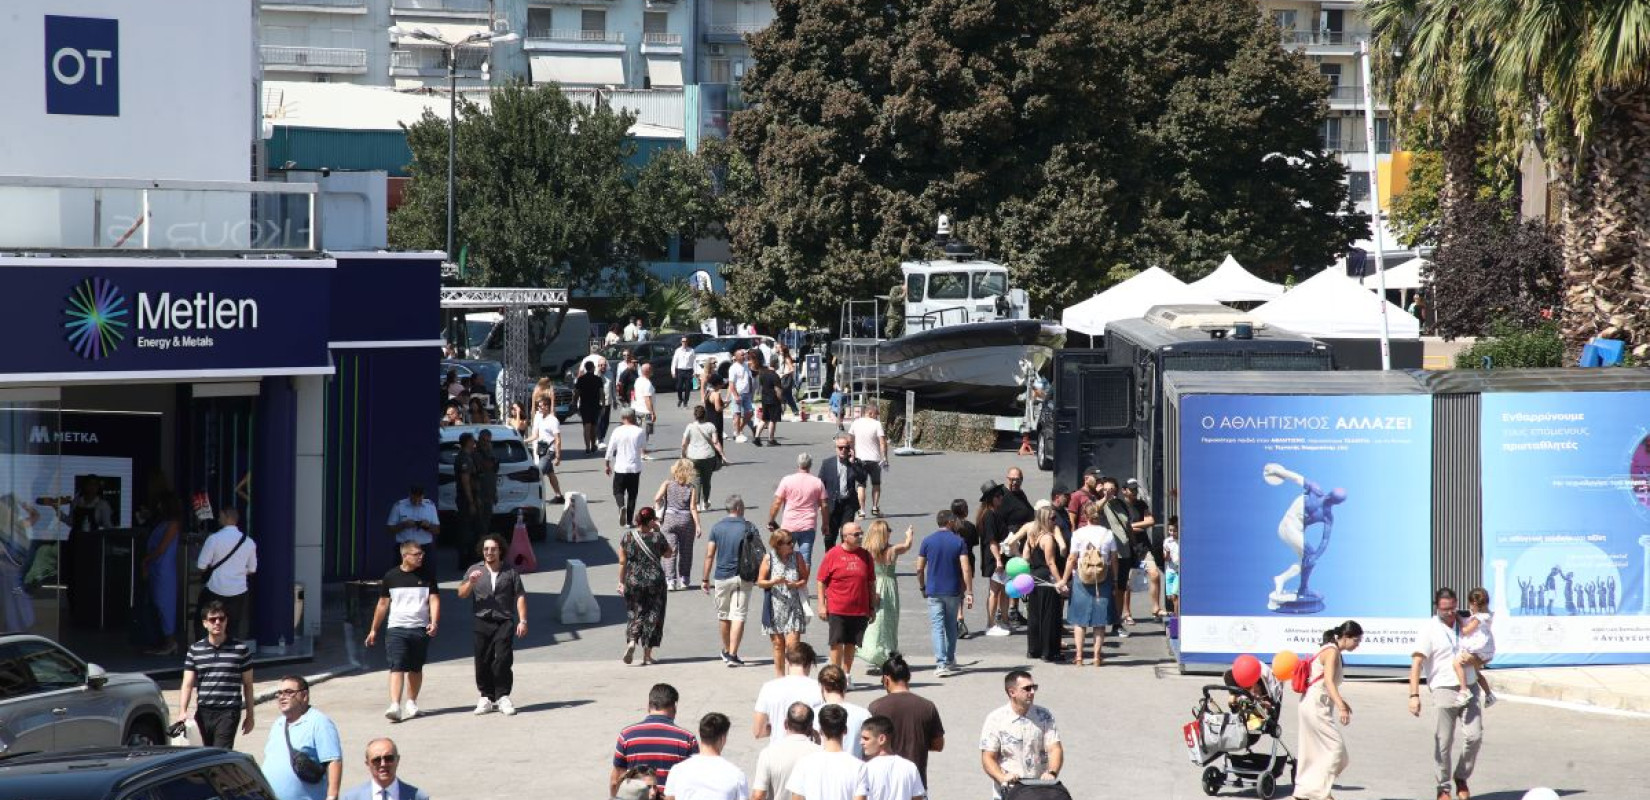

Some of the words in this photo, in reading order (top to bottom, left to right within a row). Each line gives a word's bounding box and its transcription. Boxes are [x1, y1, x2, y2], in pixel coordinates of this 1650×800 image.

[52, 47, 112, 85] OT
[138, 292, 258, 330] Metlen
[137, 336, 171, 349] Energy
[172, 336, 181, 347] &
[182, 335, 214, 347] Metals
[1201, 416, 1215, 429] Ο
[1220, 416, 1330, 430] ΑΘΛΗΤΙΣΜΟΣ
[1335, 416, 1412, 430] ΑΛΛΑΖΕΙ
[1501, 412, 1585, 422] Ενθαρρύνουμε
[53, 432, 99, 443] METKA
[1502, 440, 1579, 451] πρωταθλητές
